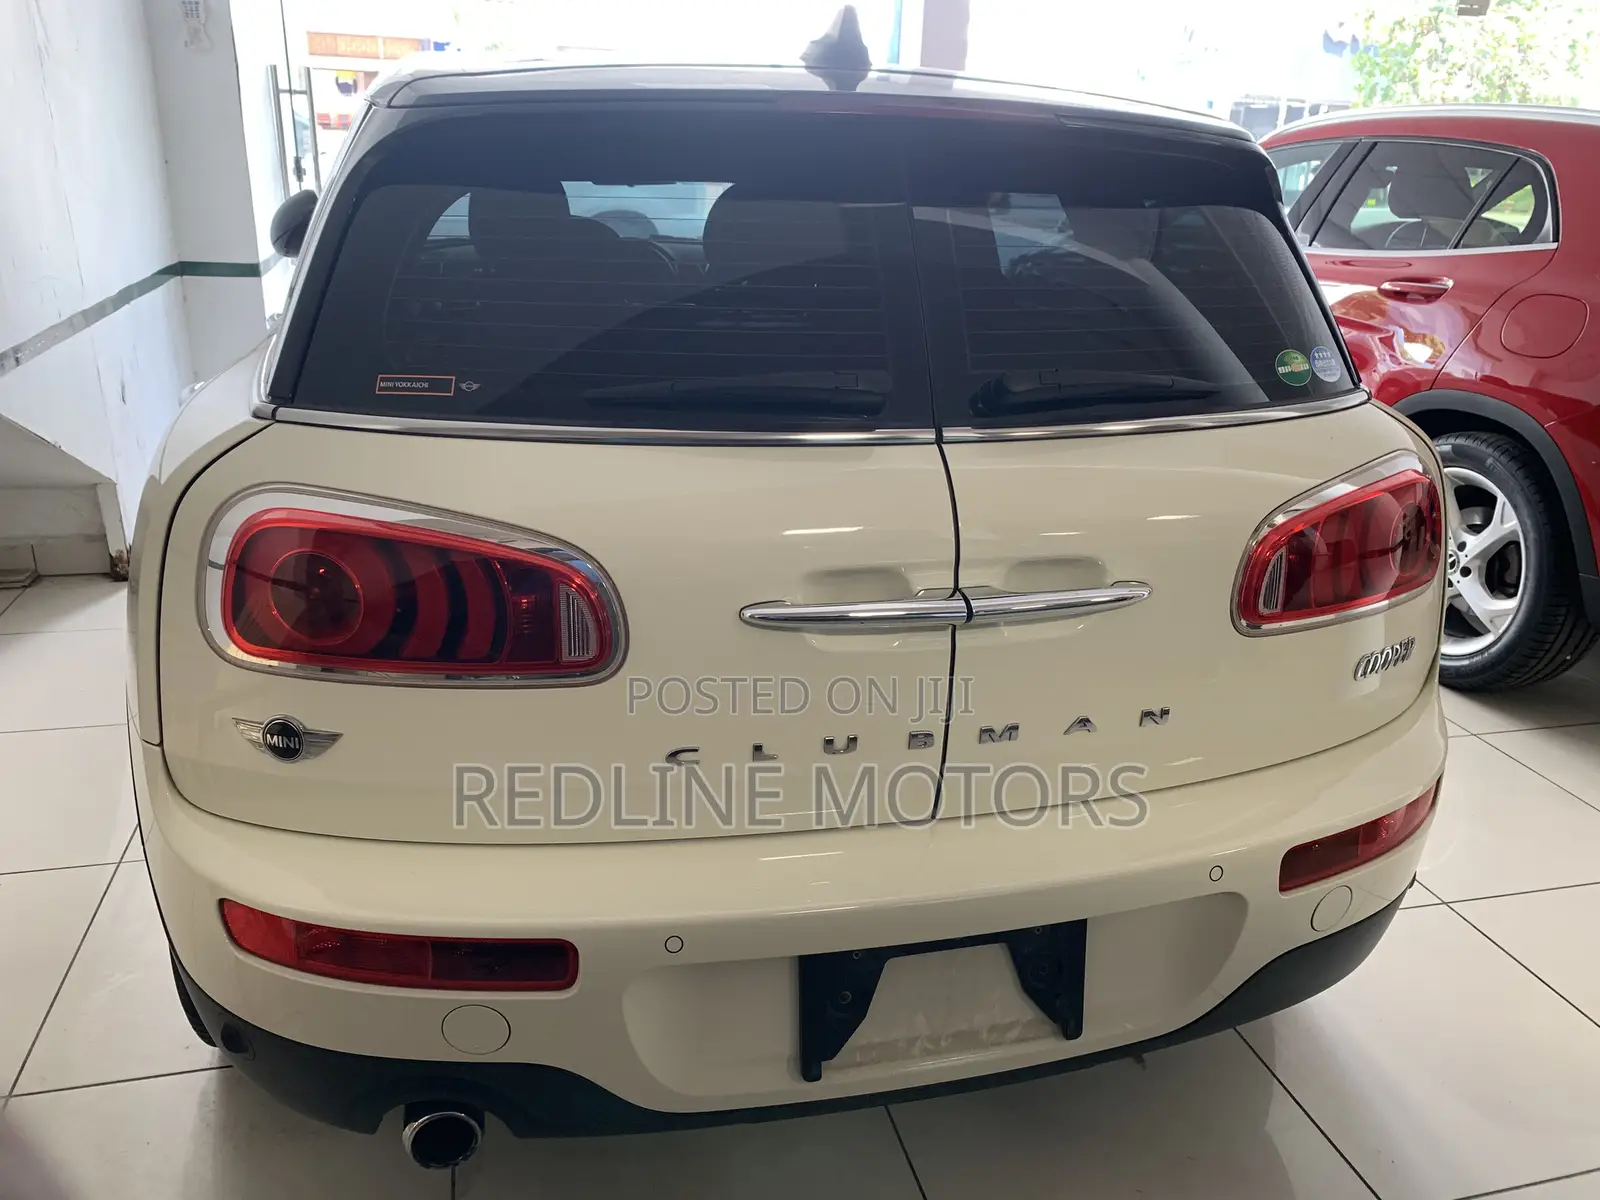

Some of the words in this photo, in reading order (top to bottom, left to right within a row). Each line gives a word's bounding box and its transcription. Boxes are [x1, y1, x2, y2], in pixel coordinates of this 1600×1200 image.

[1353, 635, 1416, 682] COOPER
[266, 733, 299, 749] MINI
[665, 706, 1171, 766] CLUBMAN
